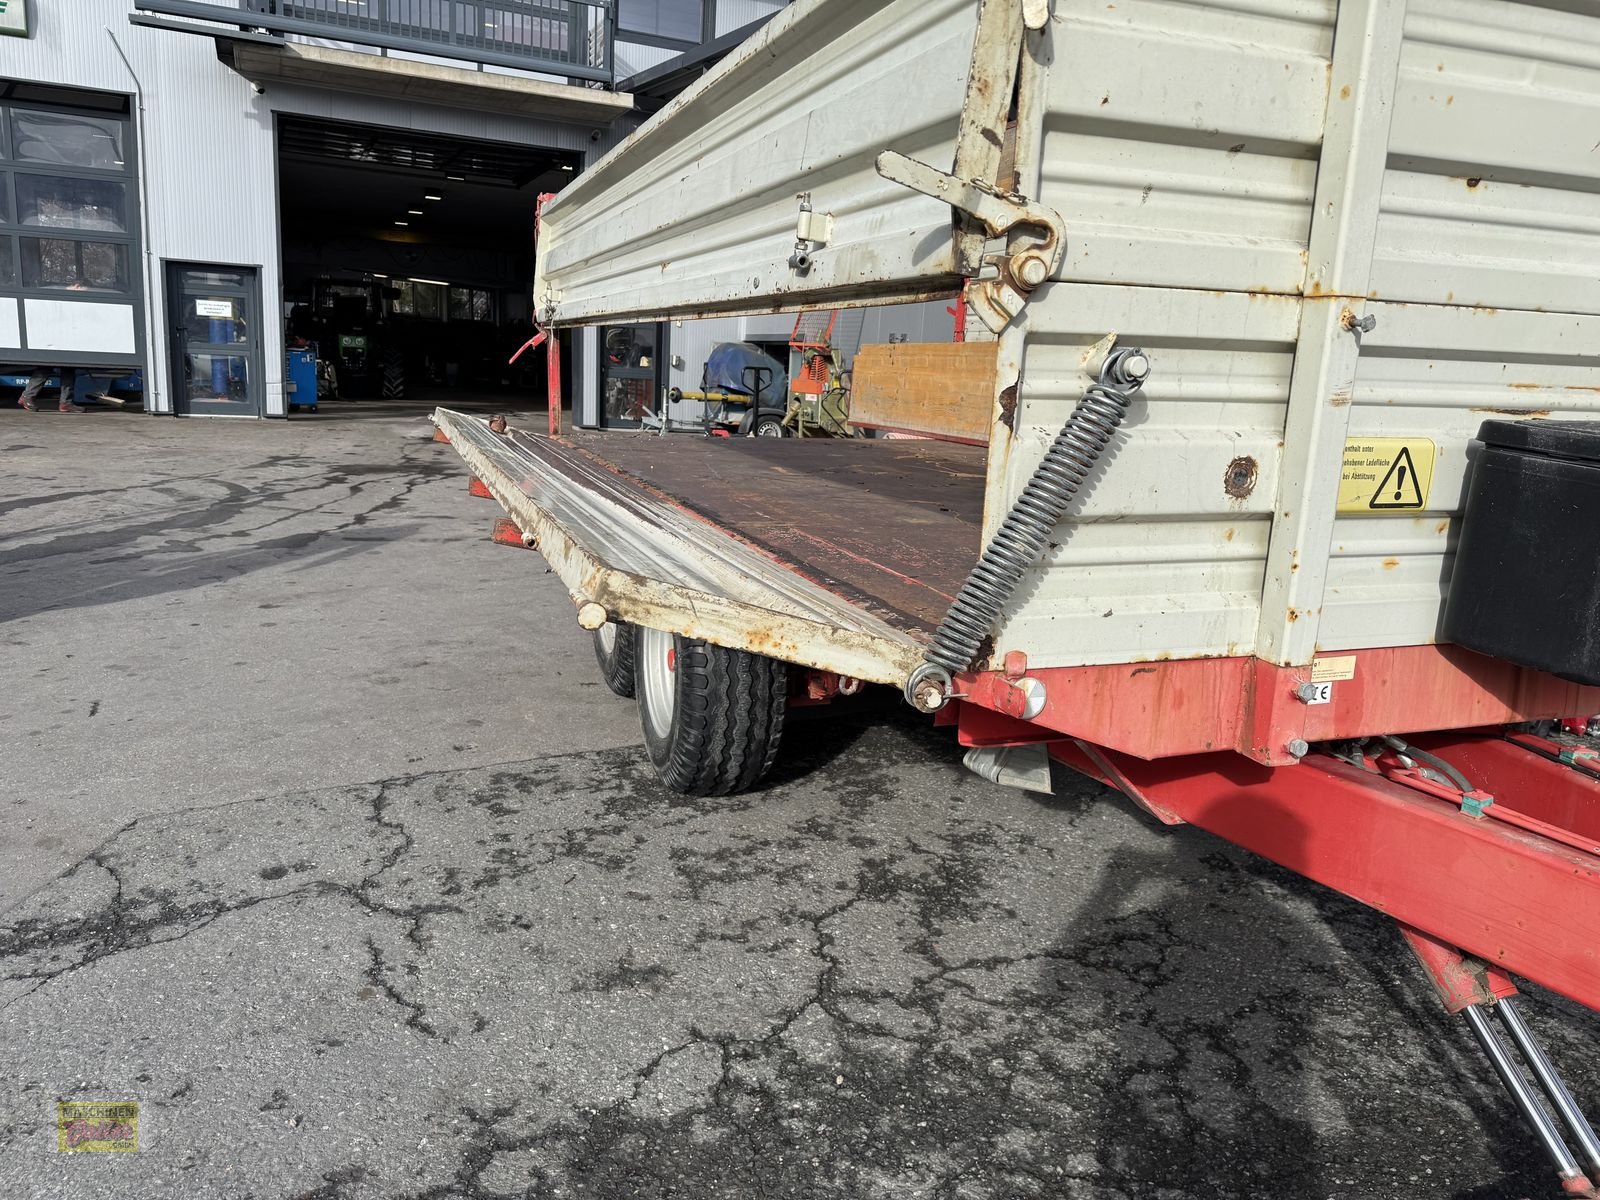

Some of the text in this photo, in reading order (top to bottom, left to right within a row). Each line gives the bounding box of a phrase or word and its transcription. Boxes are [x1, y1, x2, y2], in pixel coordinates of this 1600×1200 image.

[1344, 445, 1361, 453] enthalt
[1343, 458, 1390, 467] ehobener Ladefläche
[1342, 472, 1350, 480] bei
